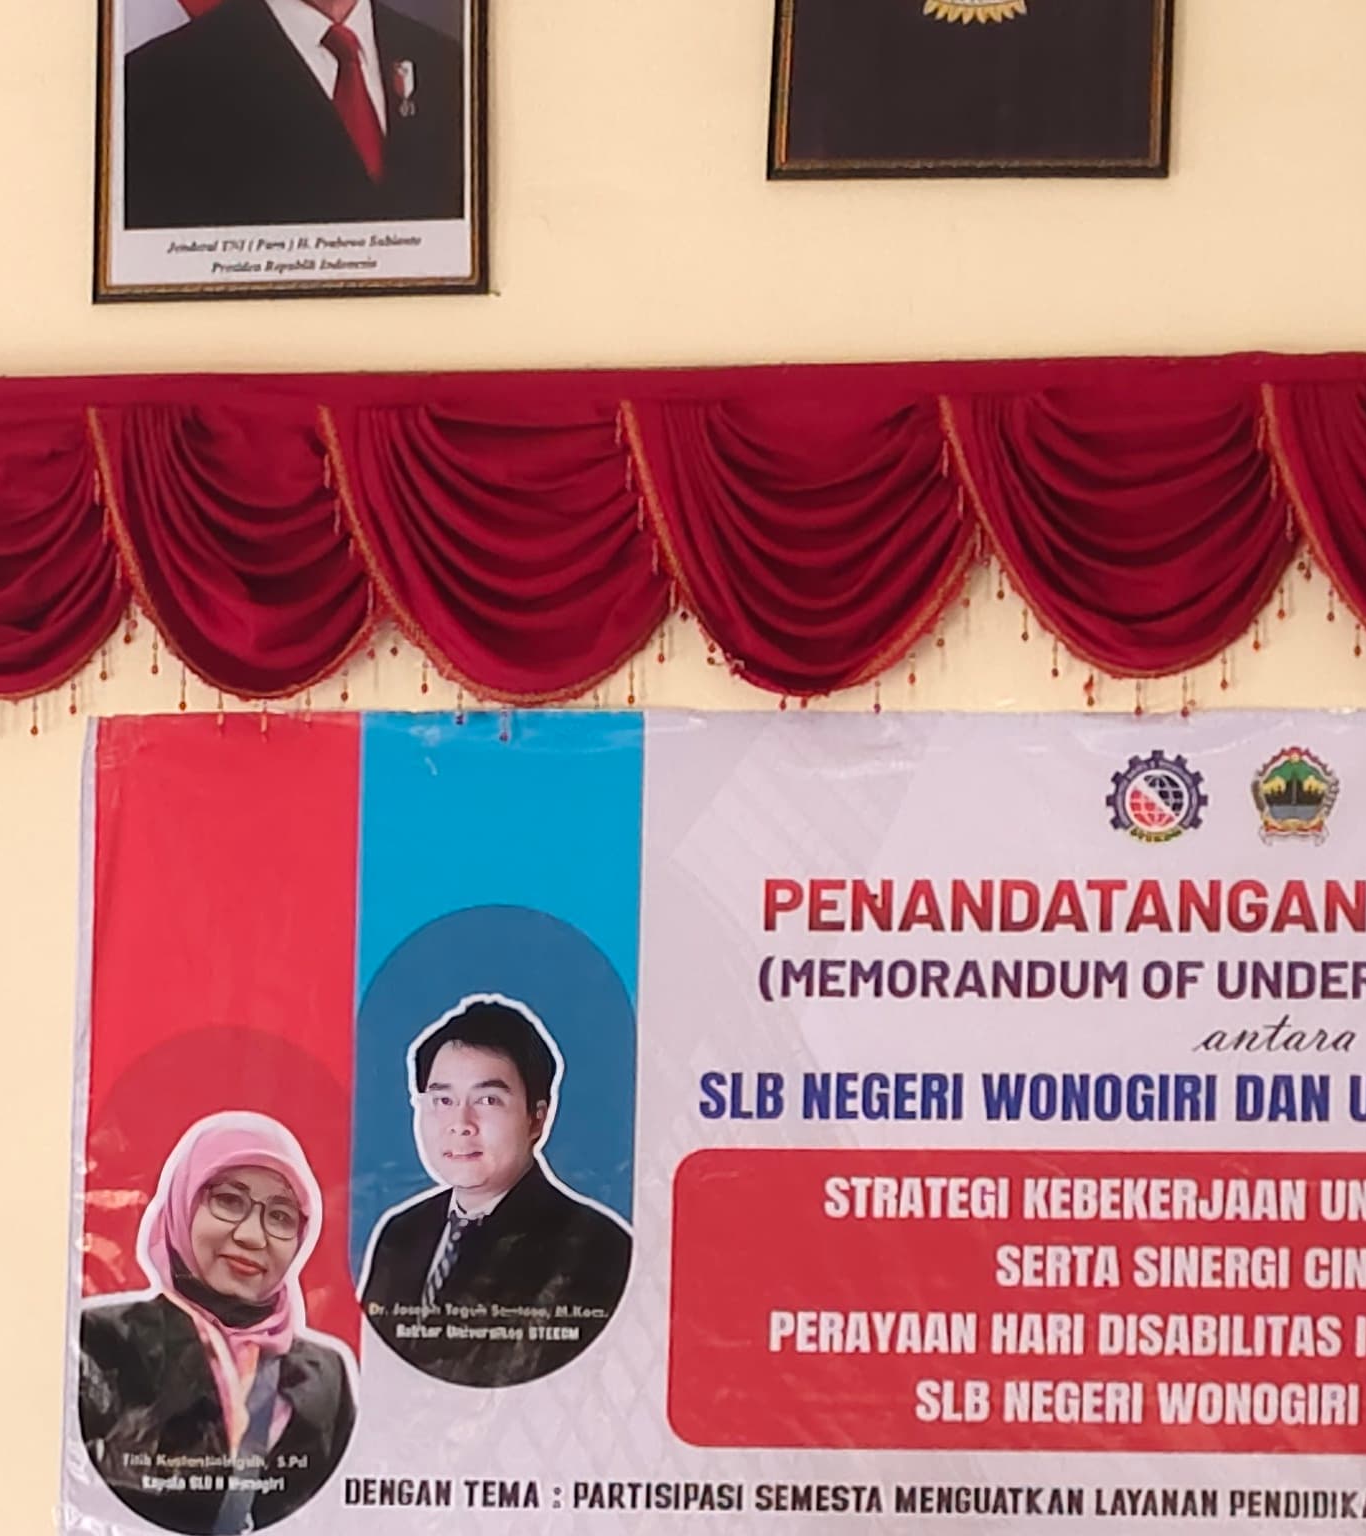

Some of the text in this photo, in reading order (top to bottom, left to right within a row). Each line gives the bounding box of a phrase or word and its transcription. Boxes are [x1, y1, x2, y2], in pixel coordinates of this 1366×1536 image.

[758, 956, 1128, 1002] (MEMORANDUM
[1141, 961, 1205, 998] OF
[1193, 1014, 1356, 1054] antara
[698, 1072, 784, 1120] SLB
[802, 1073, 964, 1121] NEGERI
[982, 1073, 1218, 1121] WONOGIRI
[1235, 1074, 1331, 1122] DAN
[824, 1177, 1010, 1219] STRATEGI
[1023, 1178, 1307, 1221] KEBEKERJAAN
[996, 1245, 1120, 1288] SERTA
[1133, 1246, 1289, 1289] SINERGI
[769, 1310, 977, 1354] PERAYAAN
[991, 1312, 1085, 1355] HARI
[1098, 1313, 1341, 1357] DISABILITAS
[915, 1379, 990, 1423] SLB
[1002, 1380, 1144, 1424] NEGERI
[1157, 1382, 1359, 1425] WONOGIRI
[344, 1478, 452, 1507] DENGAN
[464, 1480, 540, 1508] TEMA
[573, 1482, 744, 1511] PARTISIPASI
[754, 1484, 884, 1513] SEMESTA
[894, 1486, 1085, 1516] MENGUATKAN
[1095, 1487, 1218, 1517] LAYANAN
